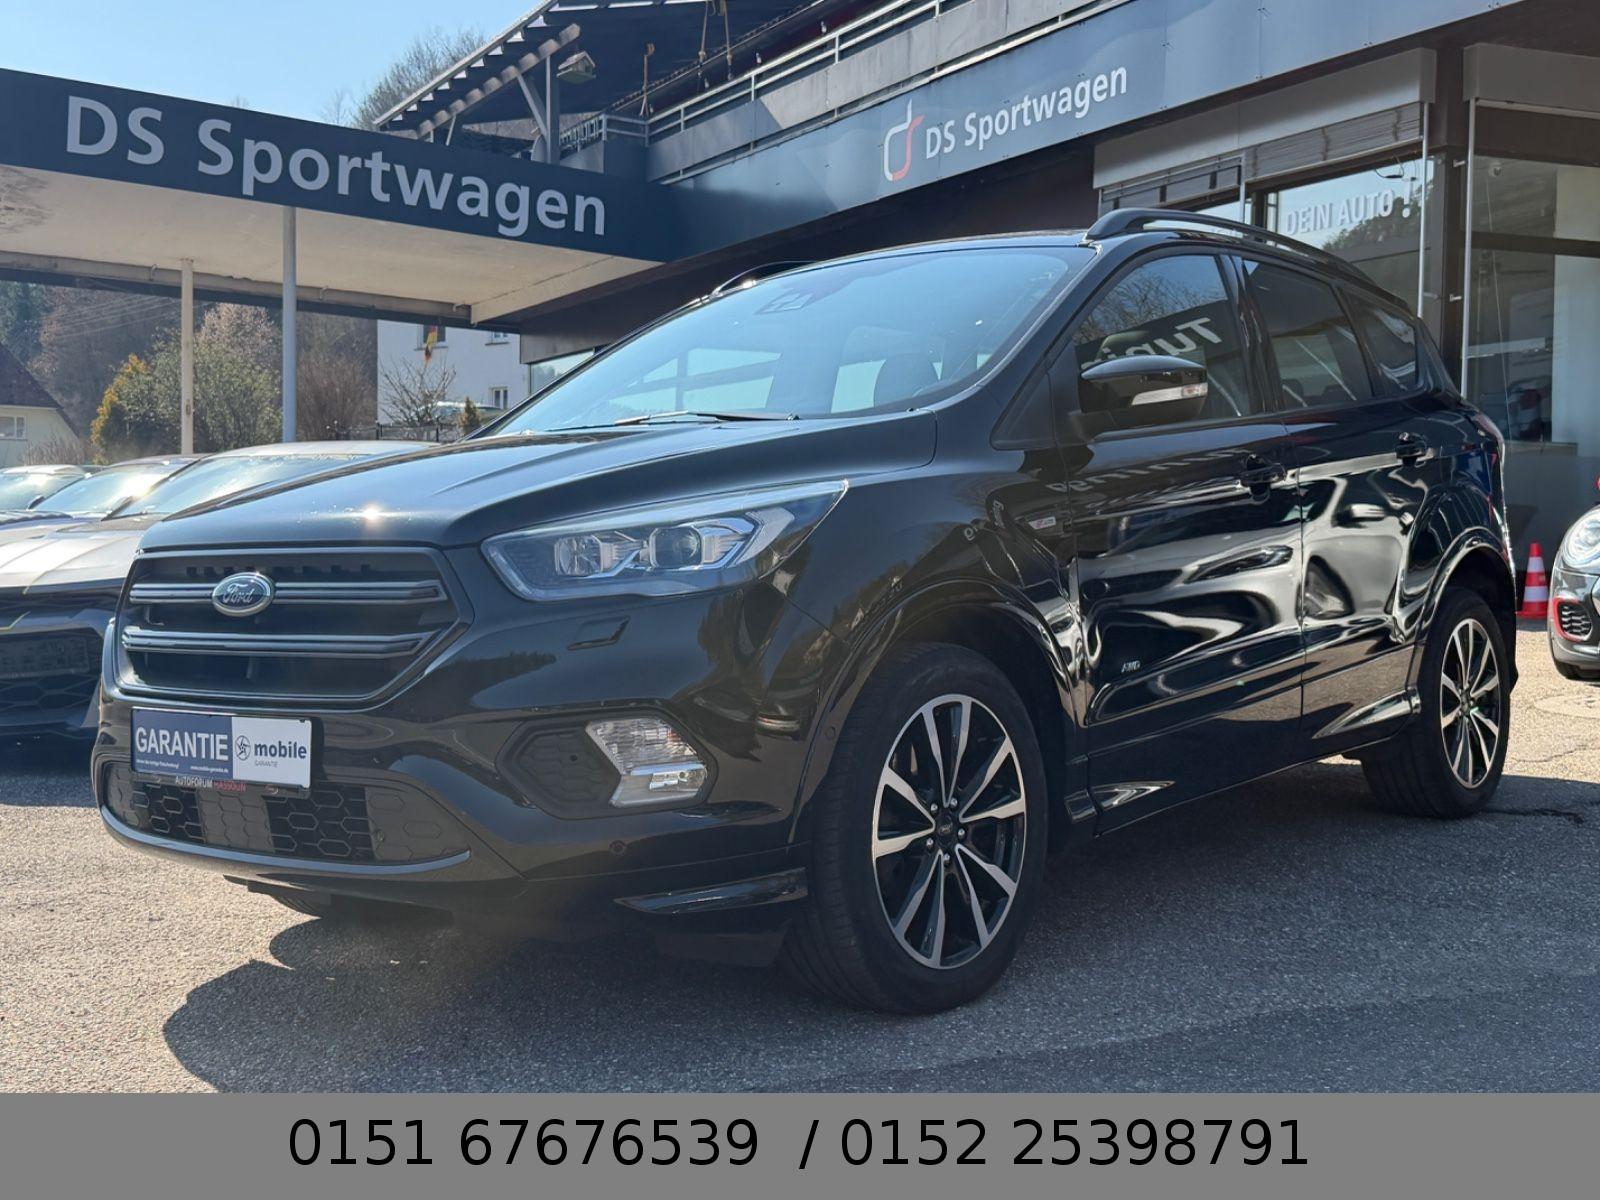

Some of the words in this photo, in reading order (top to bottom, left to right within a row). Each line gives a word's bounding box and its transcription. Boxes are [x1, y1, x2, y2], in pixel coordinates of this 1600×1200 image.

[926, 119, 956, 160] DS
[964, 66, 1128, 150] Sportwagen
[66, 95, 165, 166] DS
[197, 118, 606, 238] Sportwagen
[1286, 203, 1332, 235] DEIN
[1338, 188, 1395, 227] AUTO
[222, 582, 255, 604] Ford
[135, 726, 229, 761] GARANTIE
[254, 740, 307, 760] mobile
